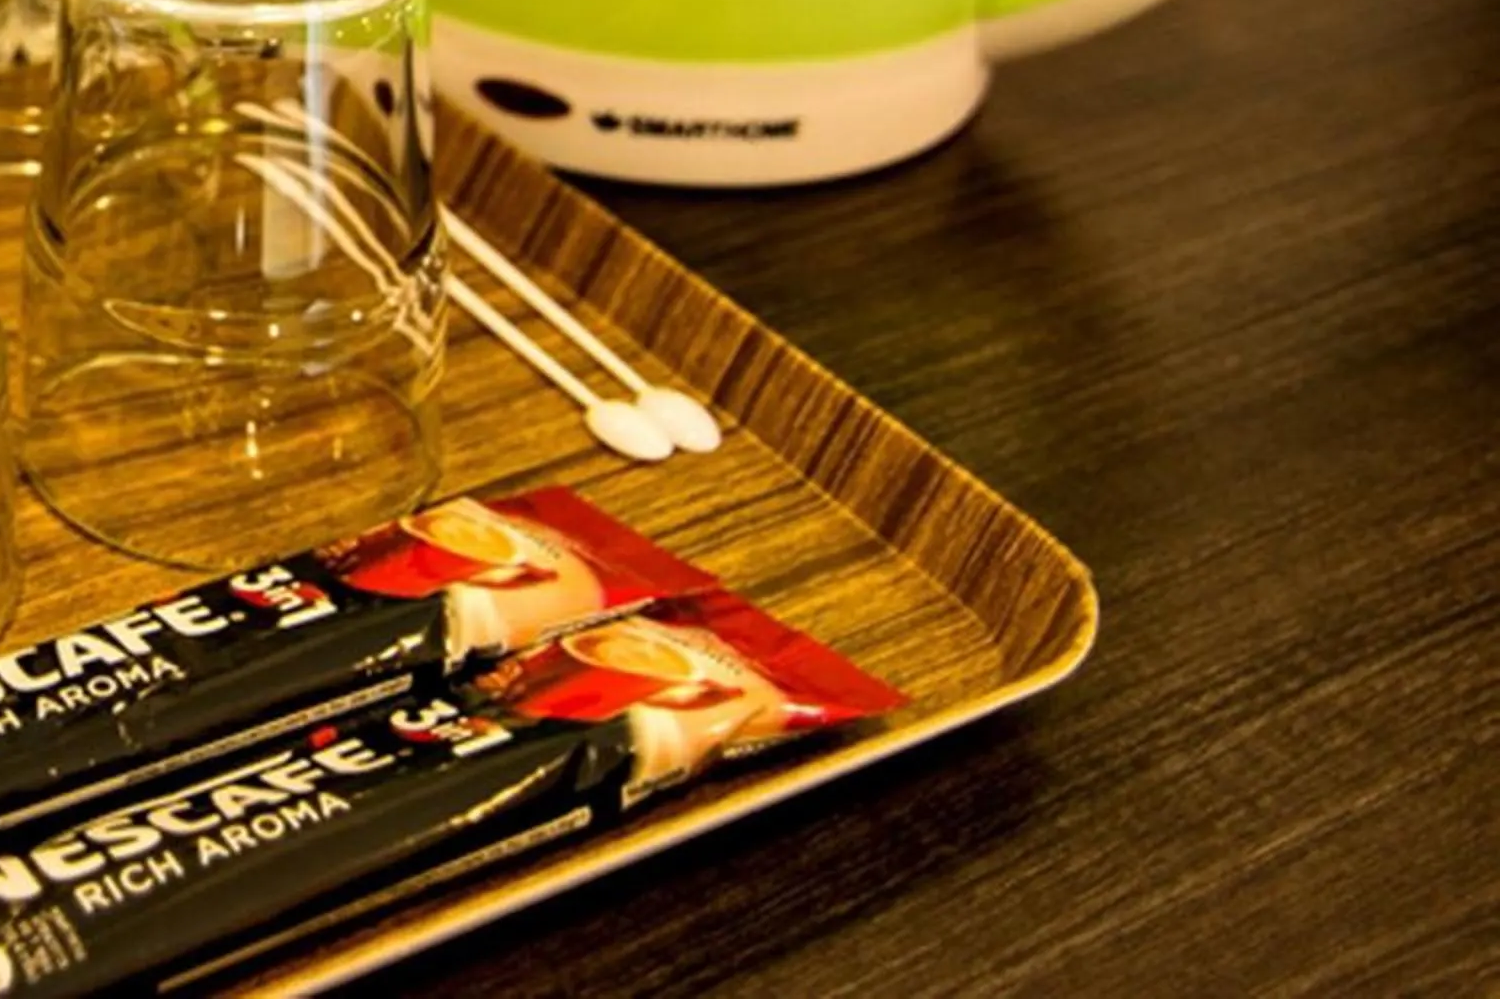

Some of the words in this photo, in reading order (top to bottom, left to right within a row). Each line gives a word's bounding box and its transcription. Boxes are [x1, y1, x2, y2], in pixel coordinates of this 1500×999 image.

[36, 655, 180, 721] AROMA
[73, 849, 187, 913] RICH
[198, 791, 351, 866] AROMA
